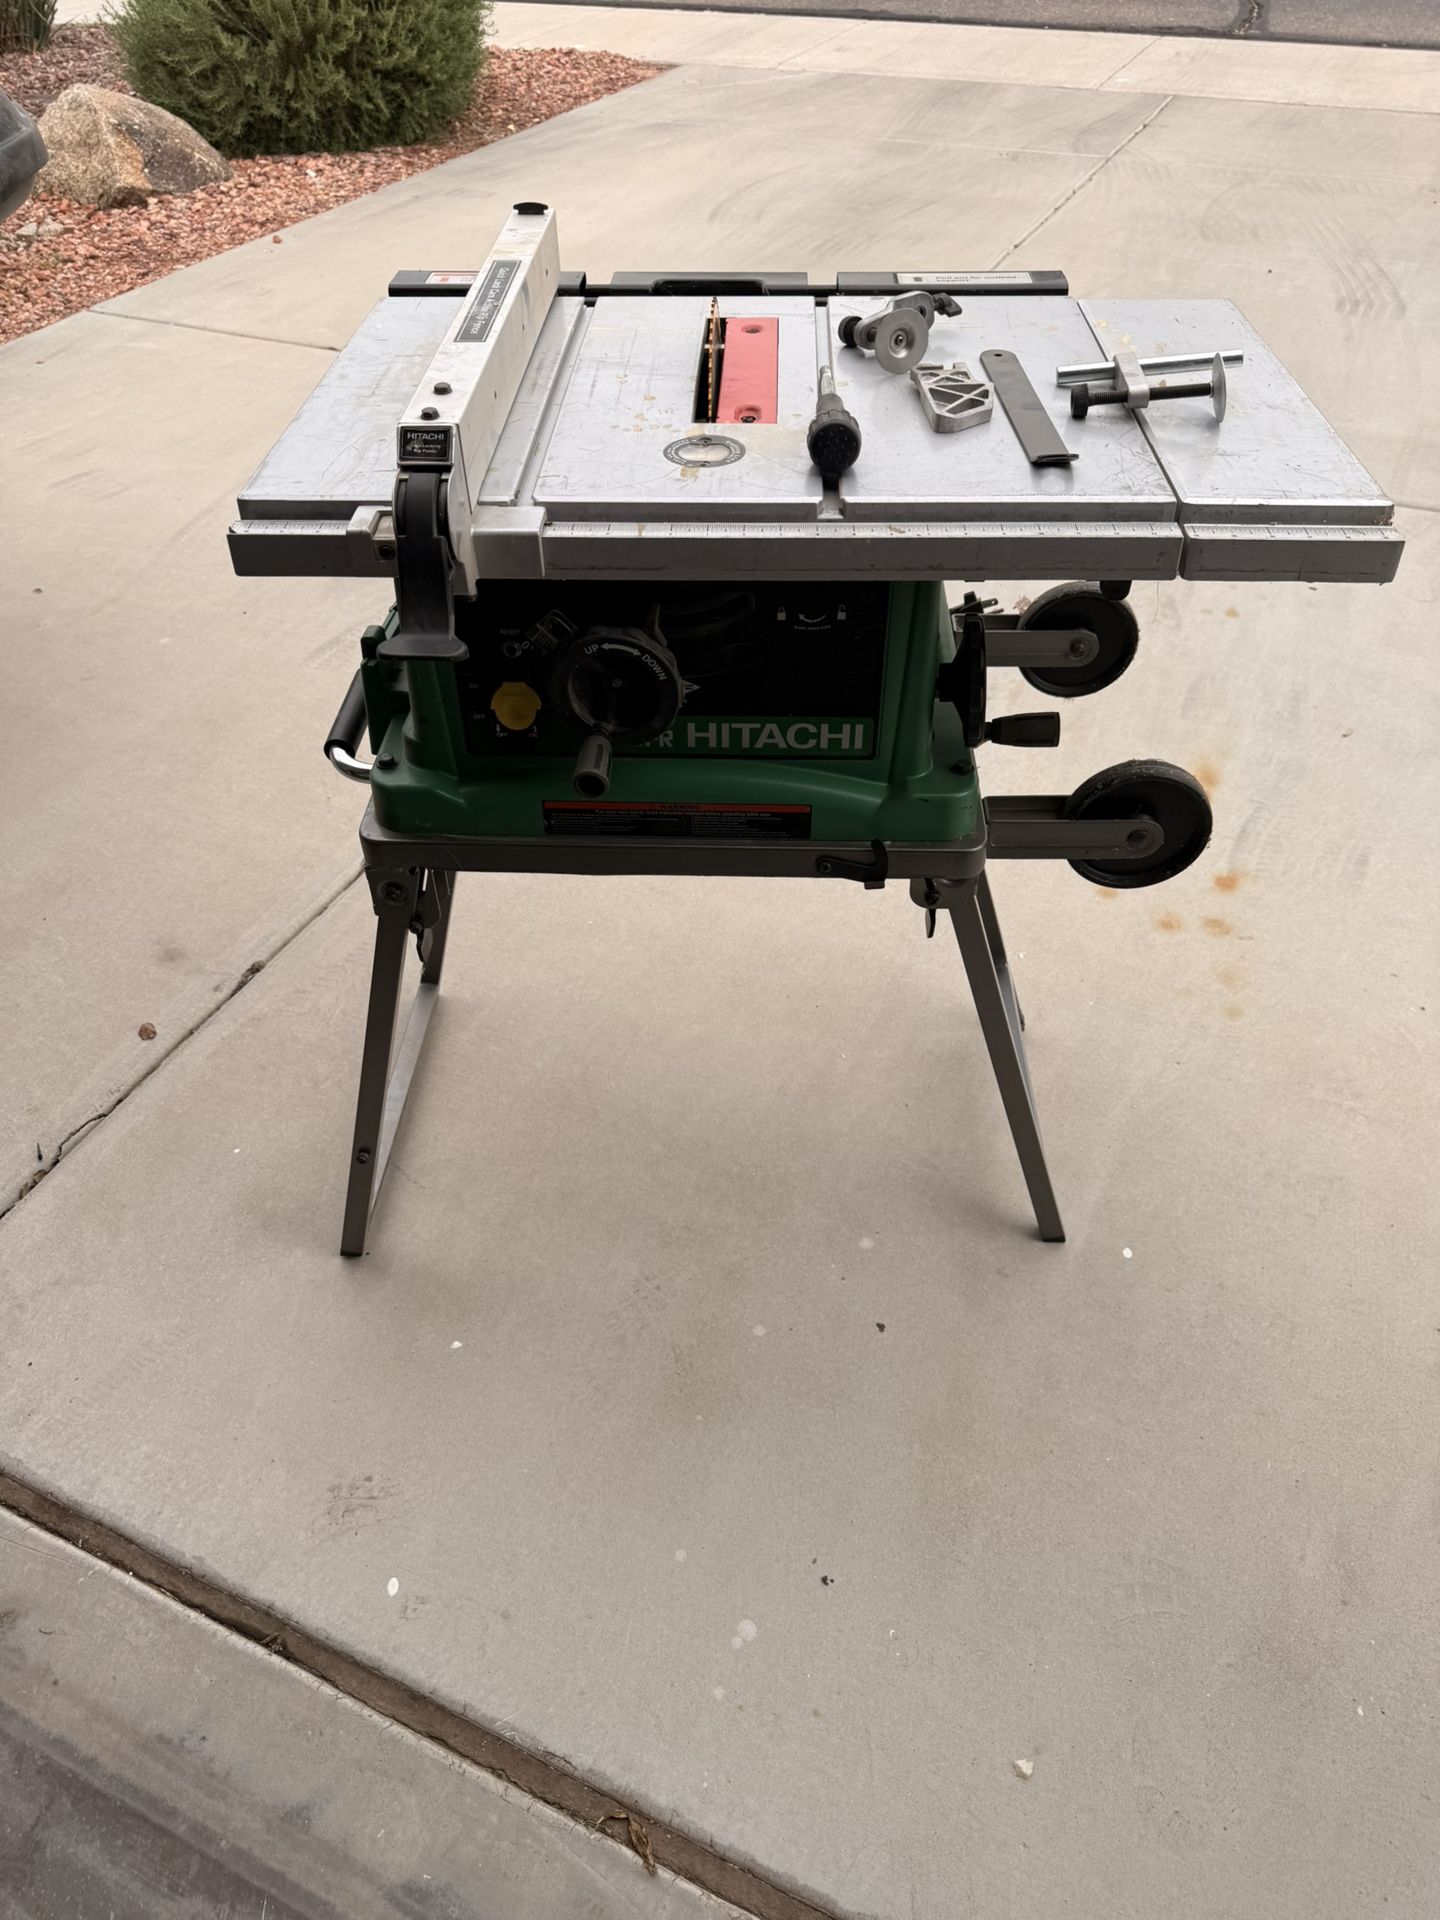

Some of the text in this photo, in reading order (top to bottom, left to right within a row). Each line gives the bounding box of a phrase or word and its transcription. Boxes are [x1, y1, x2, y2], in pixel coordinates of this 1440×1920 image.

[407, 431, 445, 441] HITACHI
[583, 644, 668, 681] UP DOWN
[686, 721, 865, 750] HITACHI
